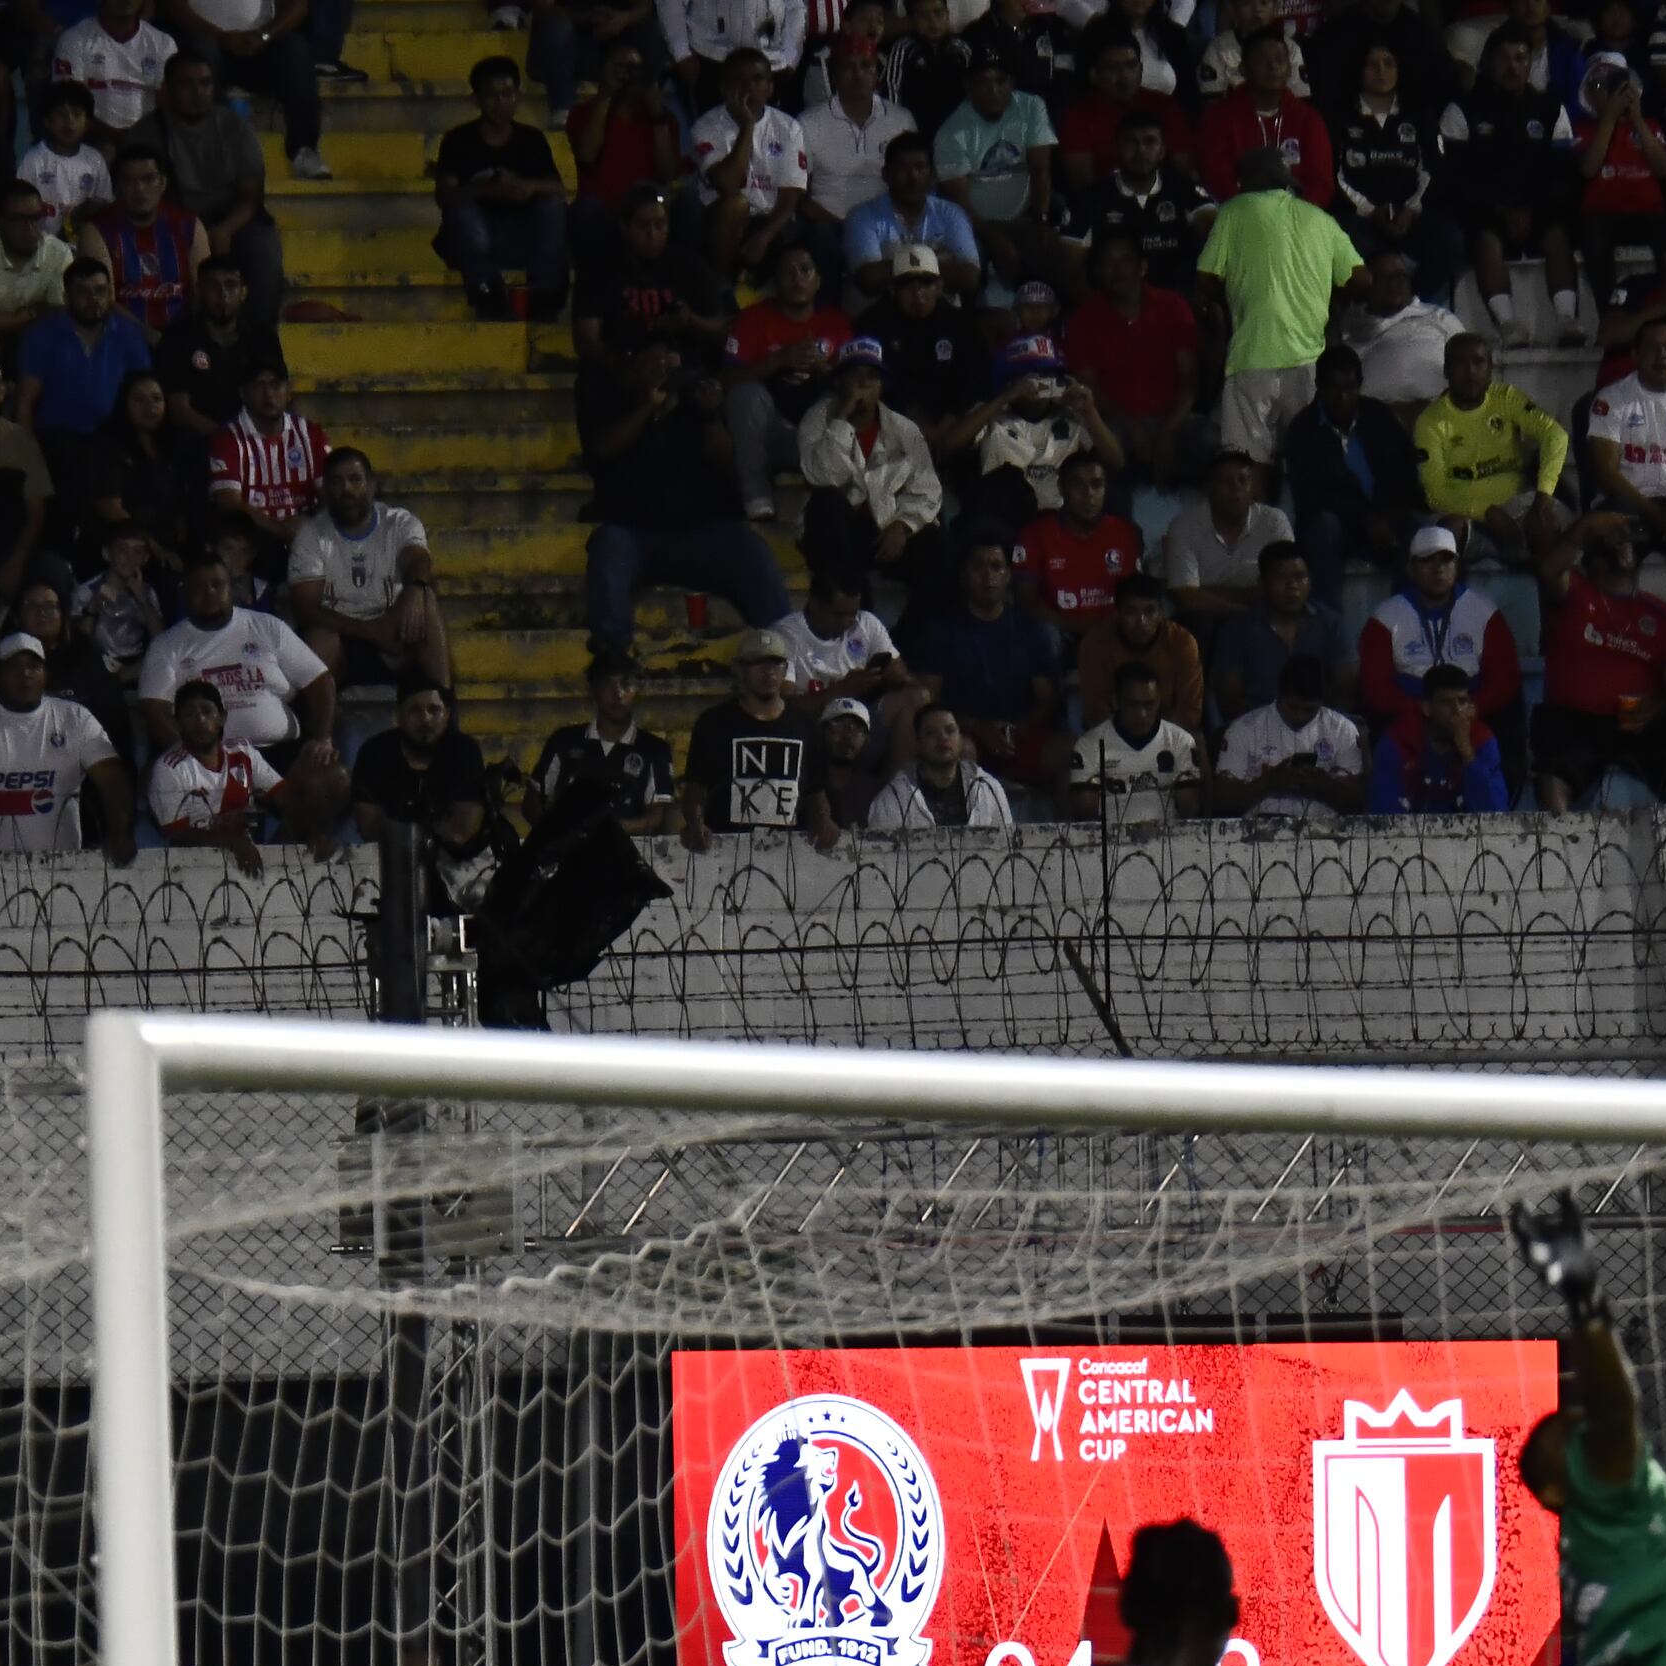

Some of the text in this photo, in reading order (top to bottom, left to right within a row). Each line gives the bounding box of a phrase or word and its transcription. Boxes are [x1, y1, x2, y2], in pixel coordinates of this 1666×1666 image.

[1079, 1357, 1148, 1375] Concacaf
[1078, 1379, 1197, 1405] CENTRAL
[1079, 1408, 1214, 1434] AMERICAN
[1079, 1439, 1127, 1461] CUP
[776, 1638, 879, 1666] FUND. 1912
